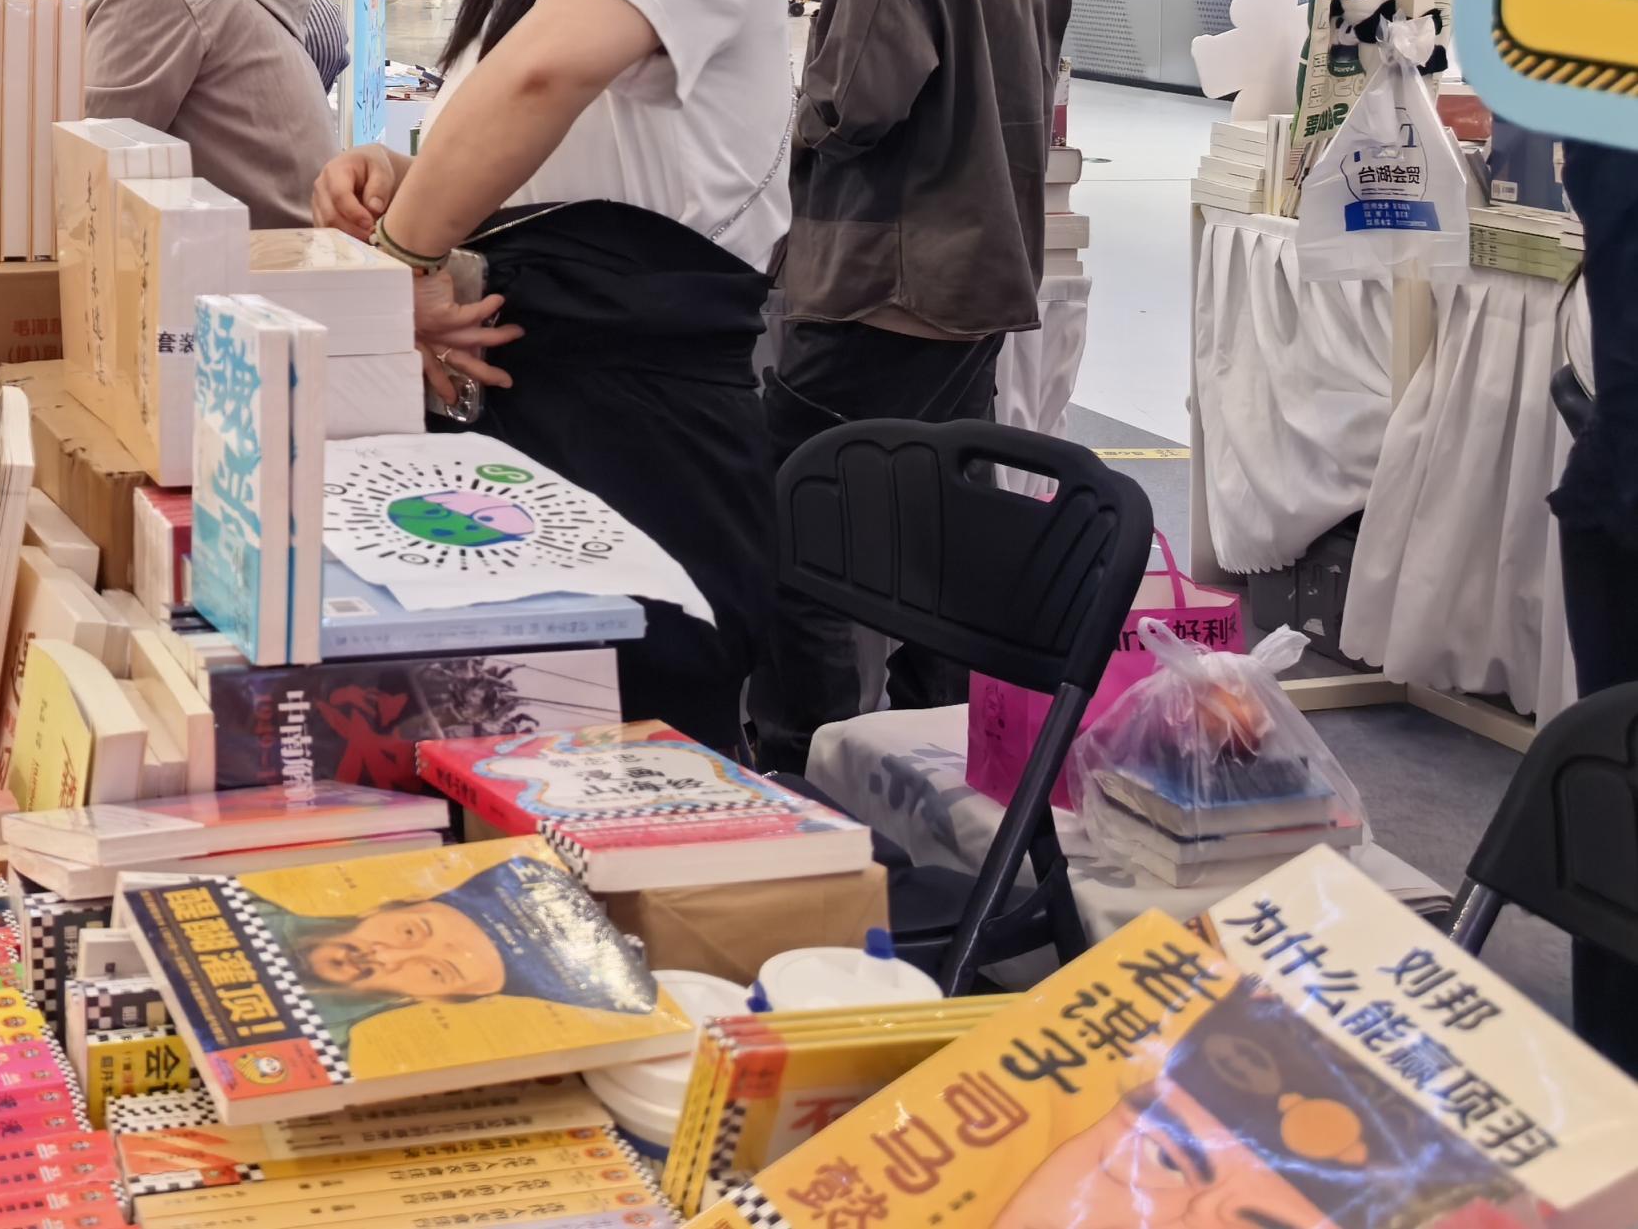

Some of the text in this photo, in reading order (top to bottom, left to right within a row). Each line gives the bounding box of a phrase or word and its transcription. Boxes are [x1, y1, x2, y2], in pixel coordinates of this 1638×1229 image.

[1223, 898, 1560, 1168] 为什么能赢项羽
[1376, 943, 1504, 1033] 刘邦
